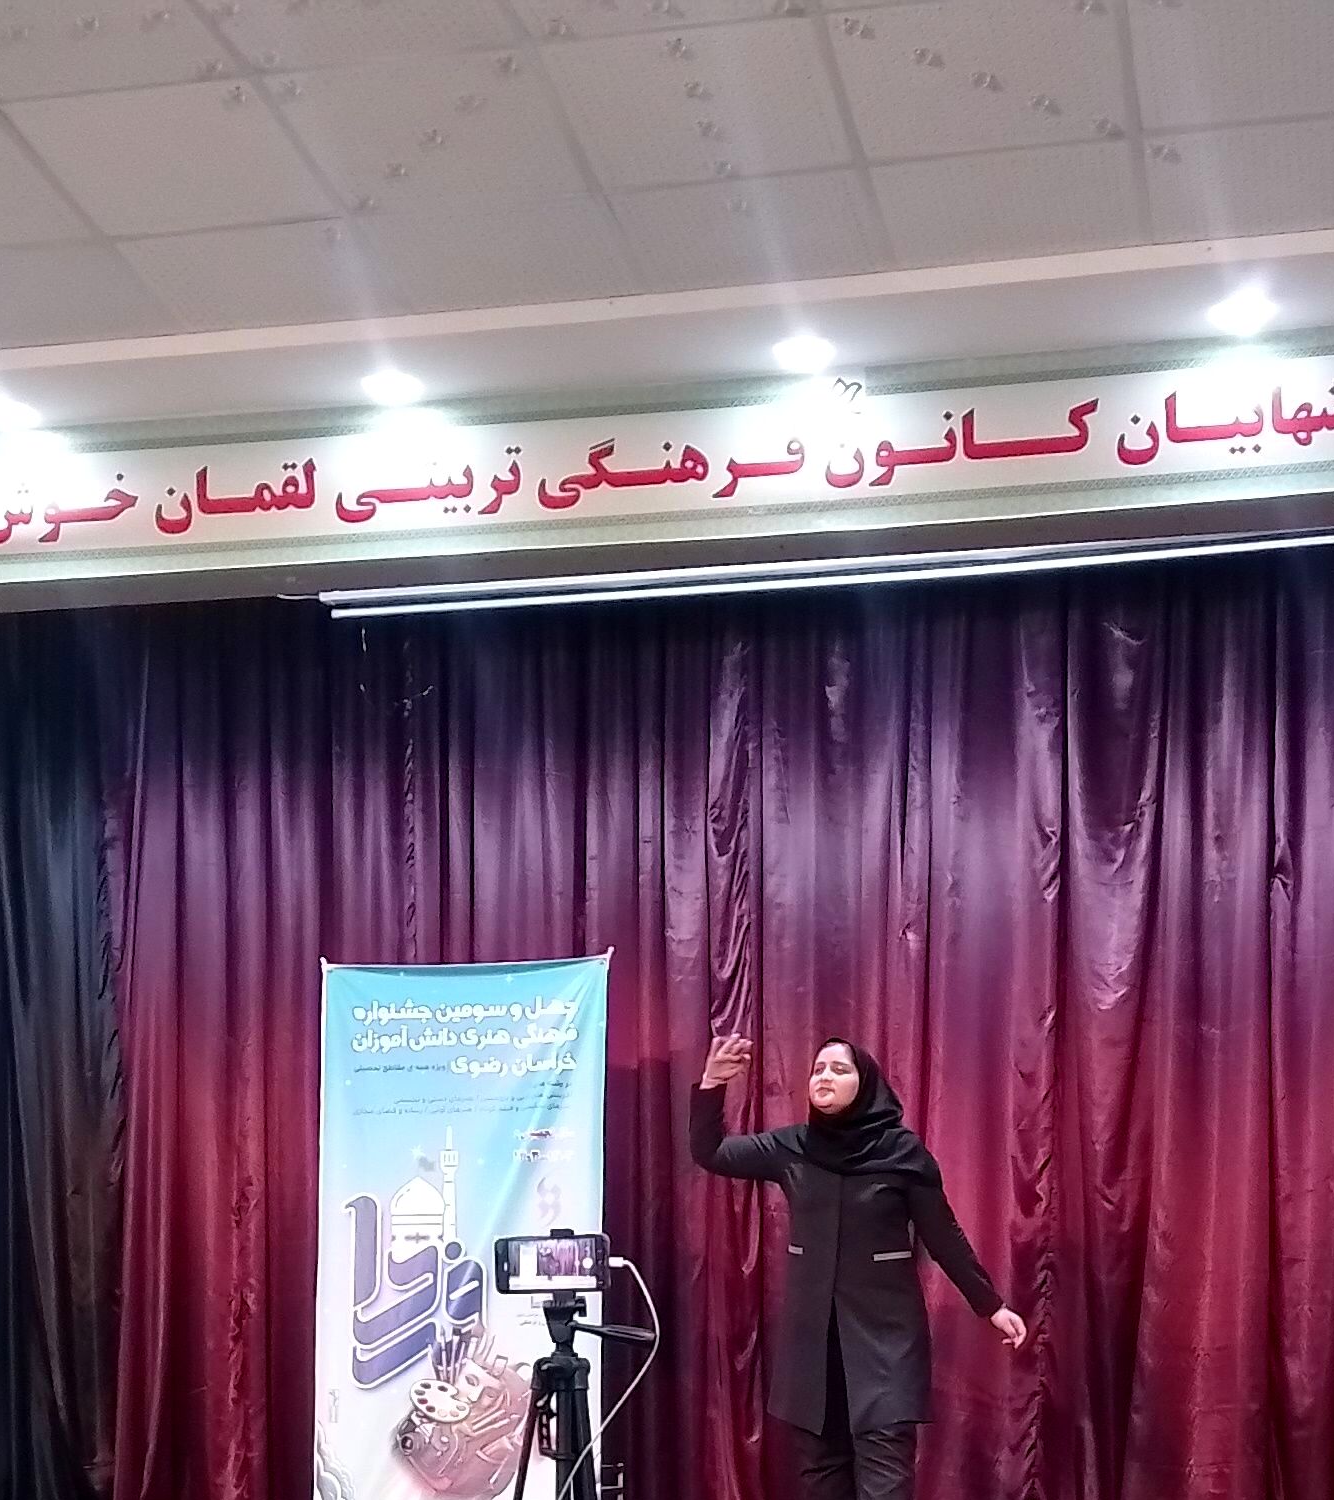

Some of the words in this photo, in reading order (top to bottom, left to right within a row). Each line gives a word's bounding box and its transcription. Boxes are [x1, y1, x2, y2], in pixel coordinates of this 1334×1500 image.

[824, 399, 1098, 487] کانون
[335, 446, 522, 523] تربیتی
[538, 437, 806, 510] فرهنگی
[155, 457, 318, 535] لقمان
[352, 998, 434, 1026] جشنواره
[436, 1001, 508, 1024] سومین
[509, 1003, 523, 1022] و
[351, 1024, 408, 1053] آموزان
[409, 1027, 458, 1052] دانش
[459, 1027, 510, 1050] هنری
[513, 1022, 579, 1050] فرهنگی
[450, 1055, 509, 1079] رضوی
[511, 1051, 578, 1077] خراسان
